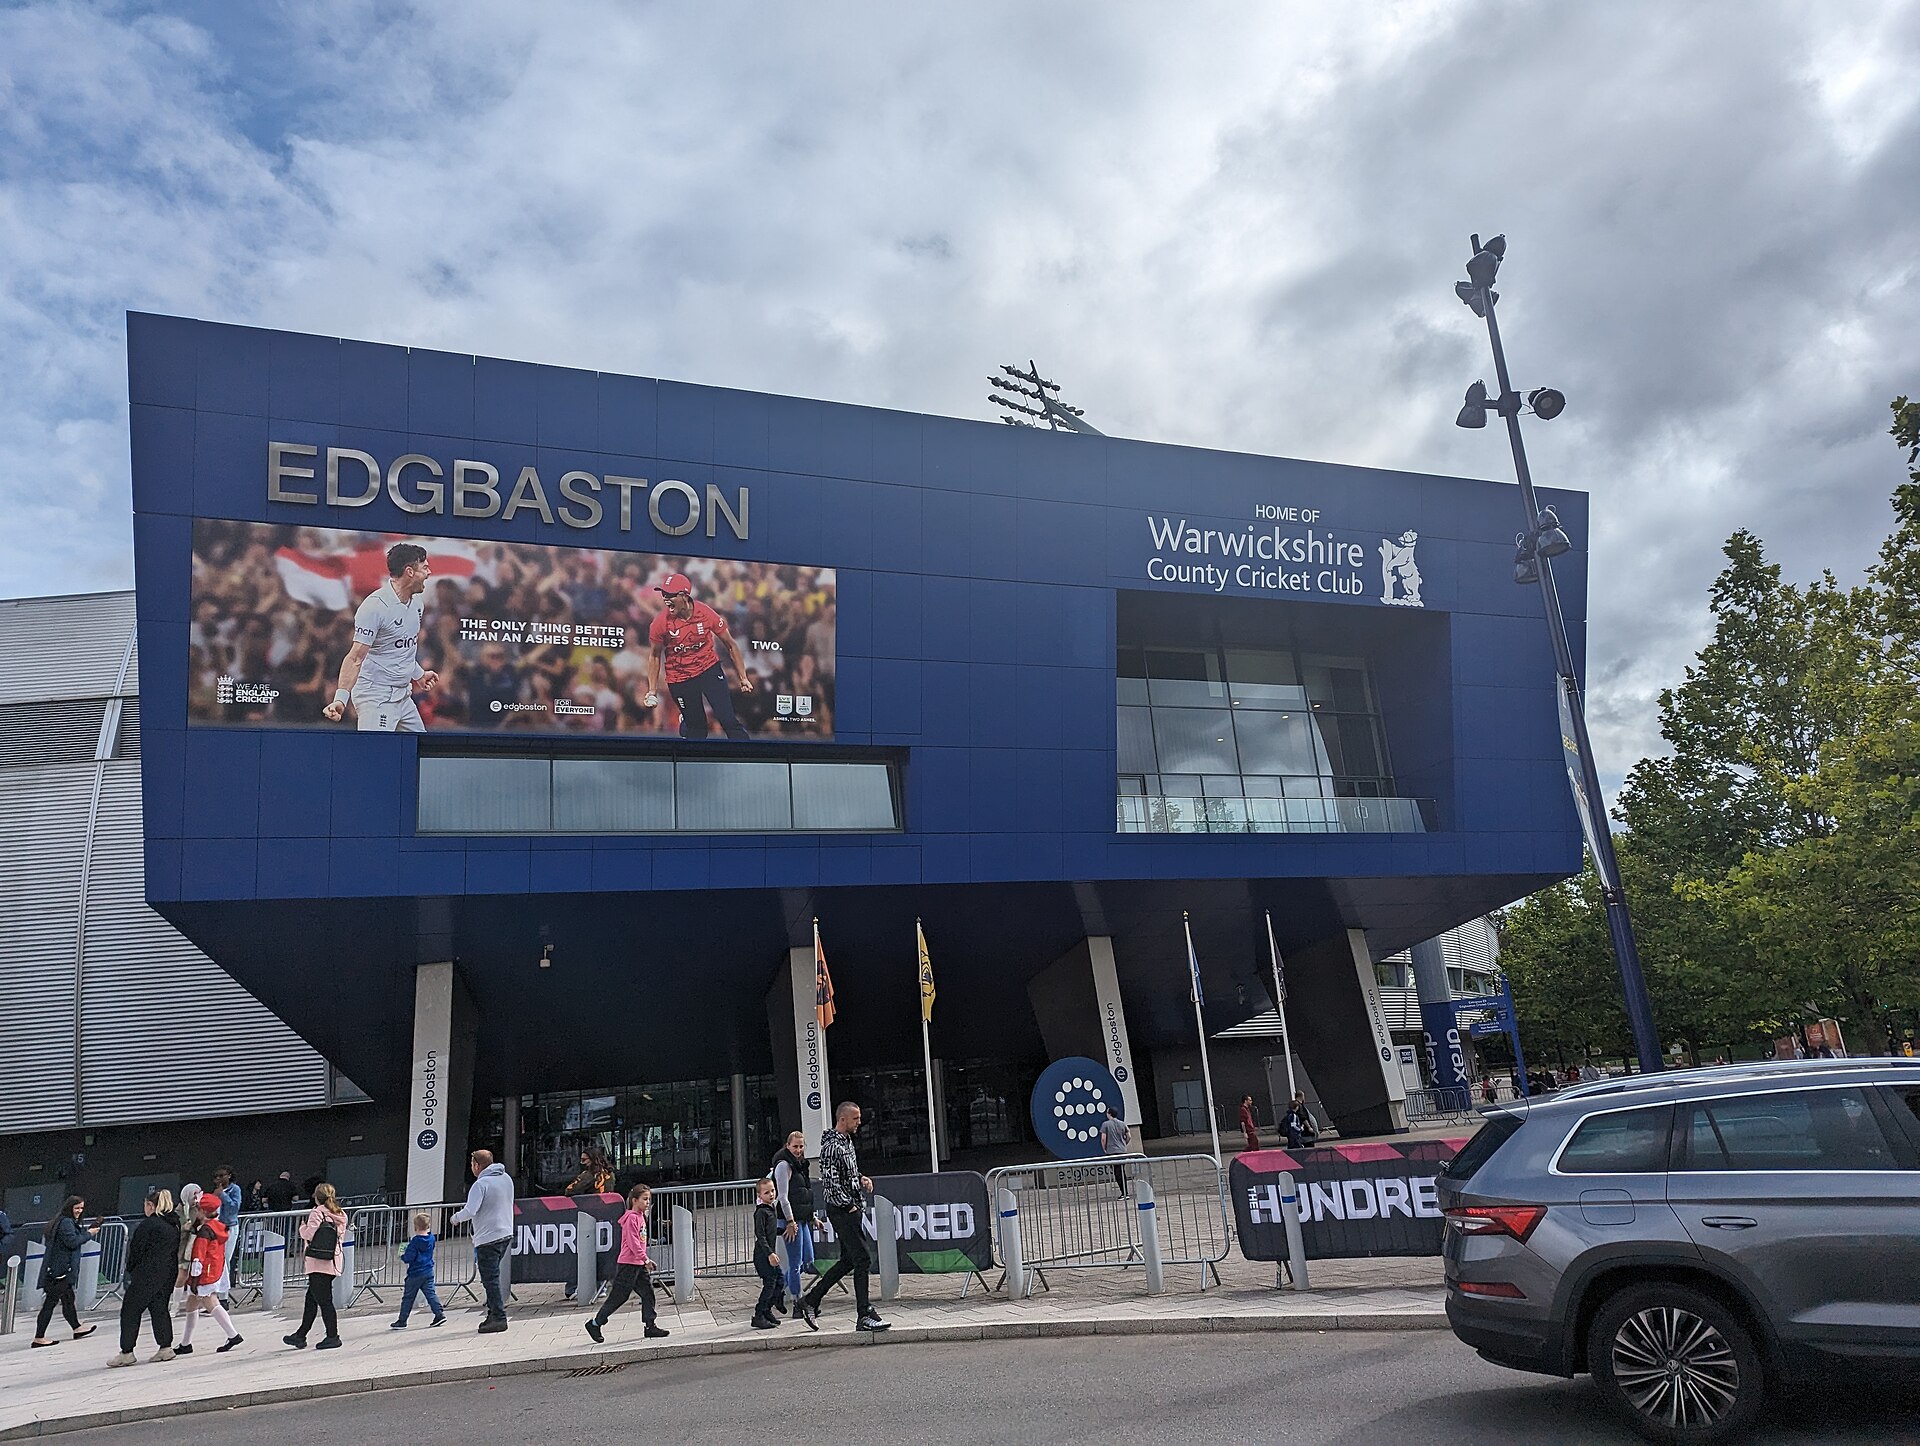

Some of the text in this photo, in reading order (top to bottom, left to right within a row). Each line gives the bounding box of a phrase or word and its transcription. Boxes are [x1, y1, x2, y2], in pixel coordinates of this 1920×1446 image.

[267, 440, 750, 540] EDGBASTON
[1255, 504, 1321, 523] HOME OF
[1147, 516, 1364, 568] Warwickshire
[1147, 557, 1364, 595] County Cricket Club
[459, 630, 625, 648] THAN AN ASHES SERIES?
[460, 618, 625, 637] THE ONLY THING BETTER
[751, 640, 783, 651] TWO.
[235, 689, 280, 698] ENGLAND
[252, 683, 271, 691] ARE
[235, 695, 275, 704] CRICKET
[503, 702, 548, 712] edgbaston
[555, 706, 594, 714] EVERYONE
[1106, 1002, 1123, 1064] edgbaston
[805, 1021, 820, 1089] edgbaston
[1446, 1028, 1468, 1083] drax
[421, 1050, 438, 1126] edgbaston
[1247, 1185, 1259, 1209] THE
[1250, 1176, 1445, 1224] HUNDRE
[511, 1221, 613, 1256] UNDRD
